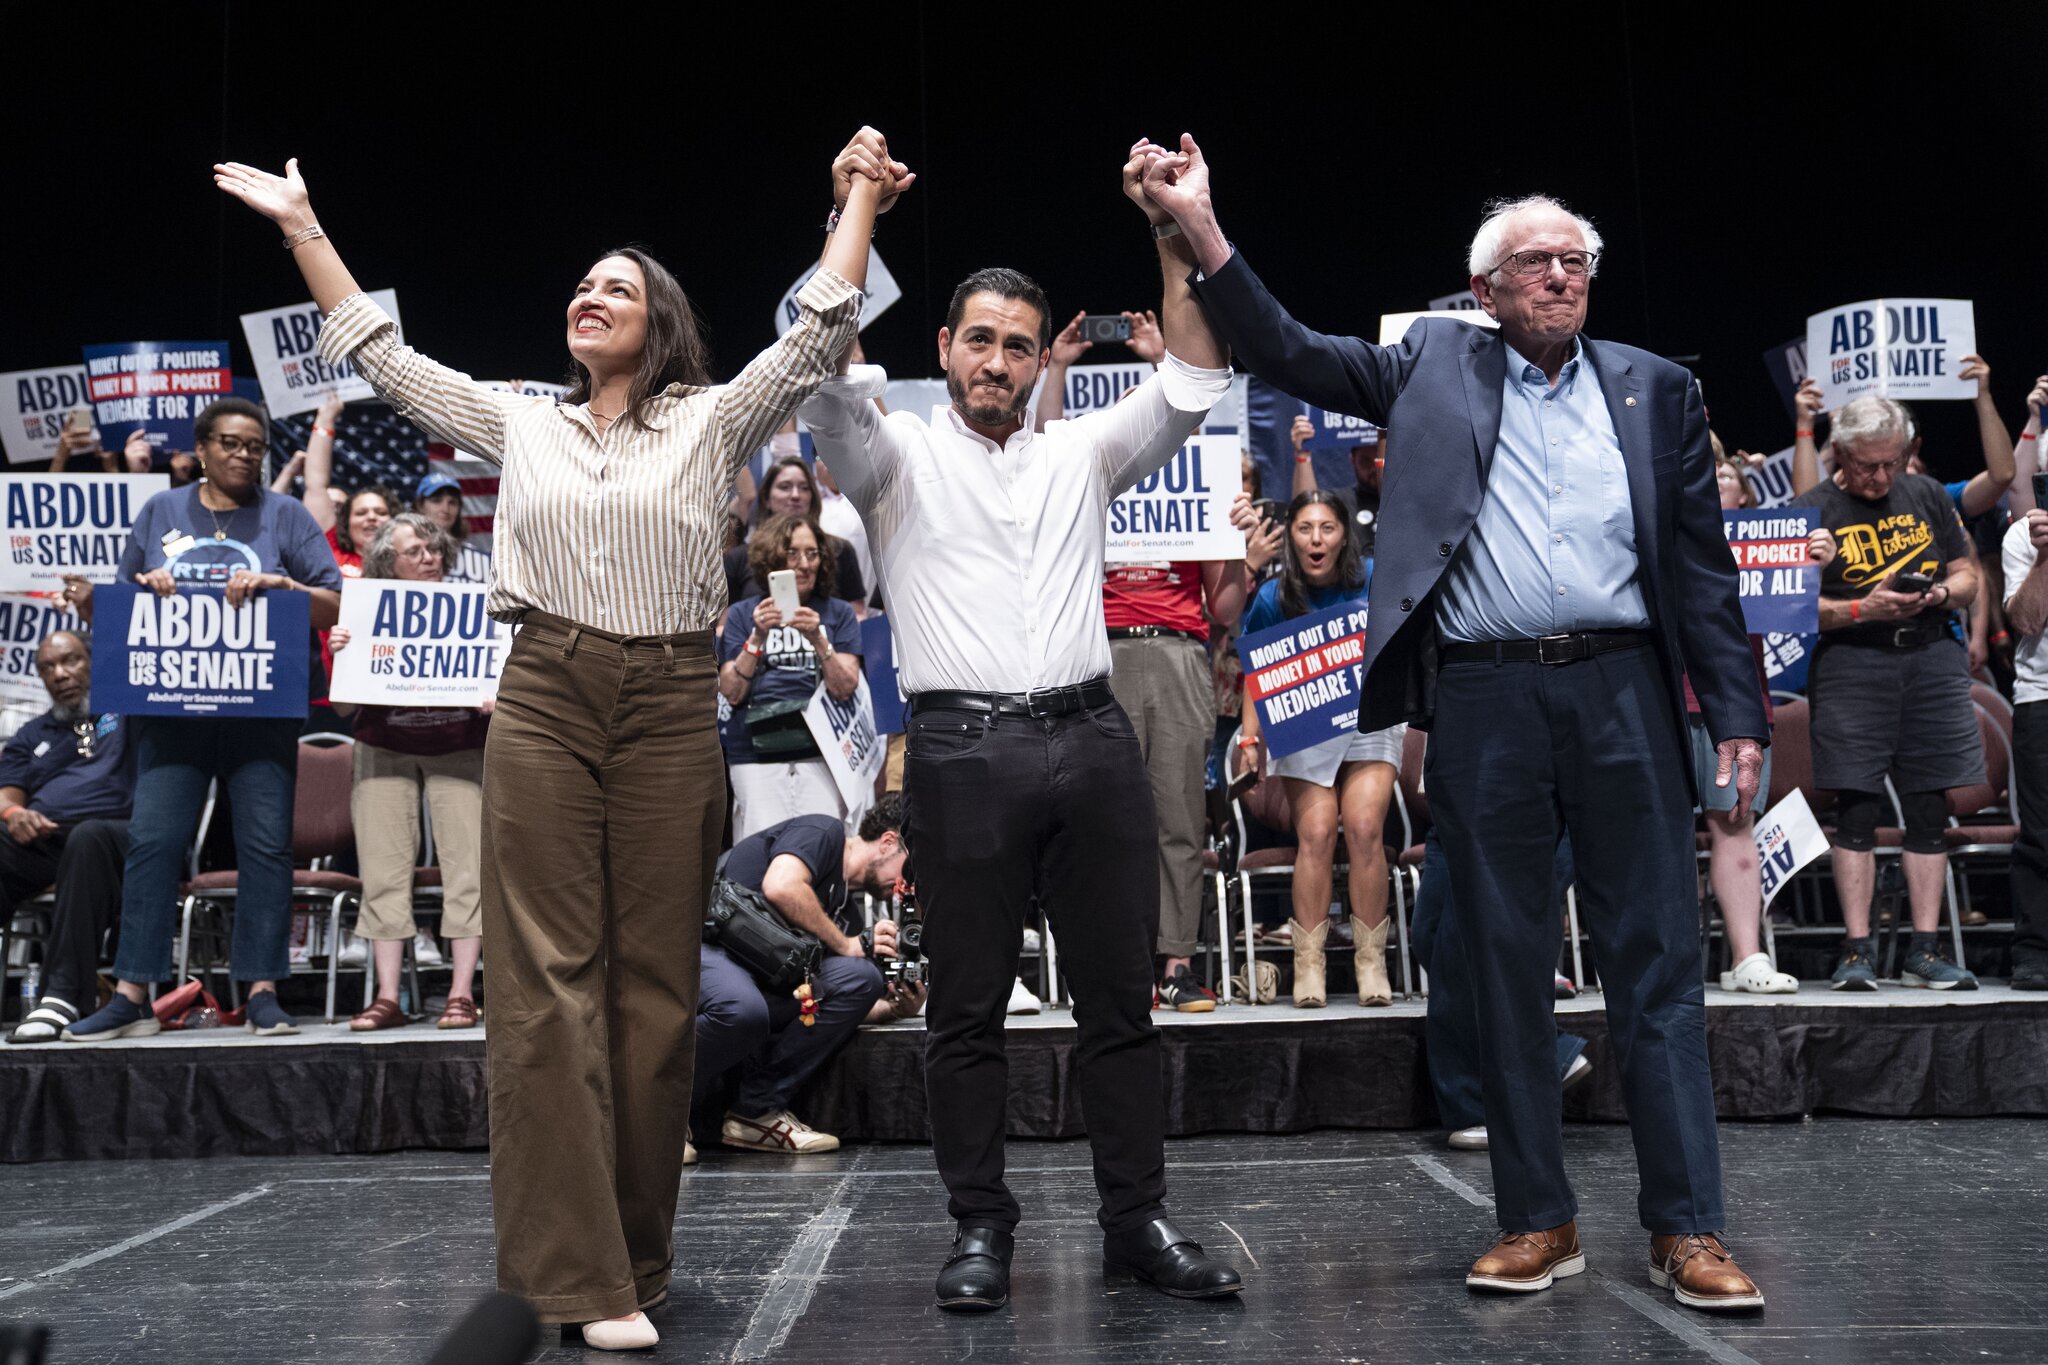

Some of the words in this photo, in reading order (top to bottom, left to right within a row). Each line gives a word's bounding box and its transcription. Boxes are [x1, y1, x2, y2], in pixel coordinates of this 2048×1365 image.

[162, 350, 220, 370] POLITICS
[1832, 358, 1850, 373] FOR
[171, 372, 220, 390] POCKET
[1832, 368, 1850, 385] US
[156, 396, 188, 420] FOR
[8, 482, 133, 528] ABDUL
[1111, 499, 1210, 533] SENATE
[1738, 518, 1807, 540] POLITICS
[1878, 514, 1916, 532] AFGE
[10, 536, 31, 550] FOR
[38, 534, 128, 566] SENAT
[1105, 539, 1194, 548] bdulForSenate.com
[1747, 543, 1807, 565] POCKET
[1835, 520, 1934, 582] District
[13, 549, 33, 564] US
[1770, 568, 1806, 596] ALL
[127, 592, 276, 650] ABDUL
[1250, 635, 1297, 670] MONEY
[1298, 624, 1326, 651] OUT
[1327, 617, 1345, 640] OF
[1348, 608, 1368, 633] PO
[129, 651, 156, 668] FOR
[372, 644, 396, 657] FOR
[400, 644, 500, 679] SENATE
[128, 666, 157, 686] US
[160, 650, 274, 690] SENATE
[371, 657, 394, 675] US
[1257, 659, 1304, 694] MONEY
[1305, 652, 1323, 675] IN
[1322, 638, 1363, 668] YOUR
[385, 683, 478, 693] AbdulForSenate.com
[1265, 670, 1351, 725] MEDICARE
